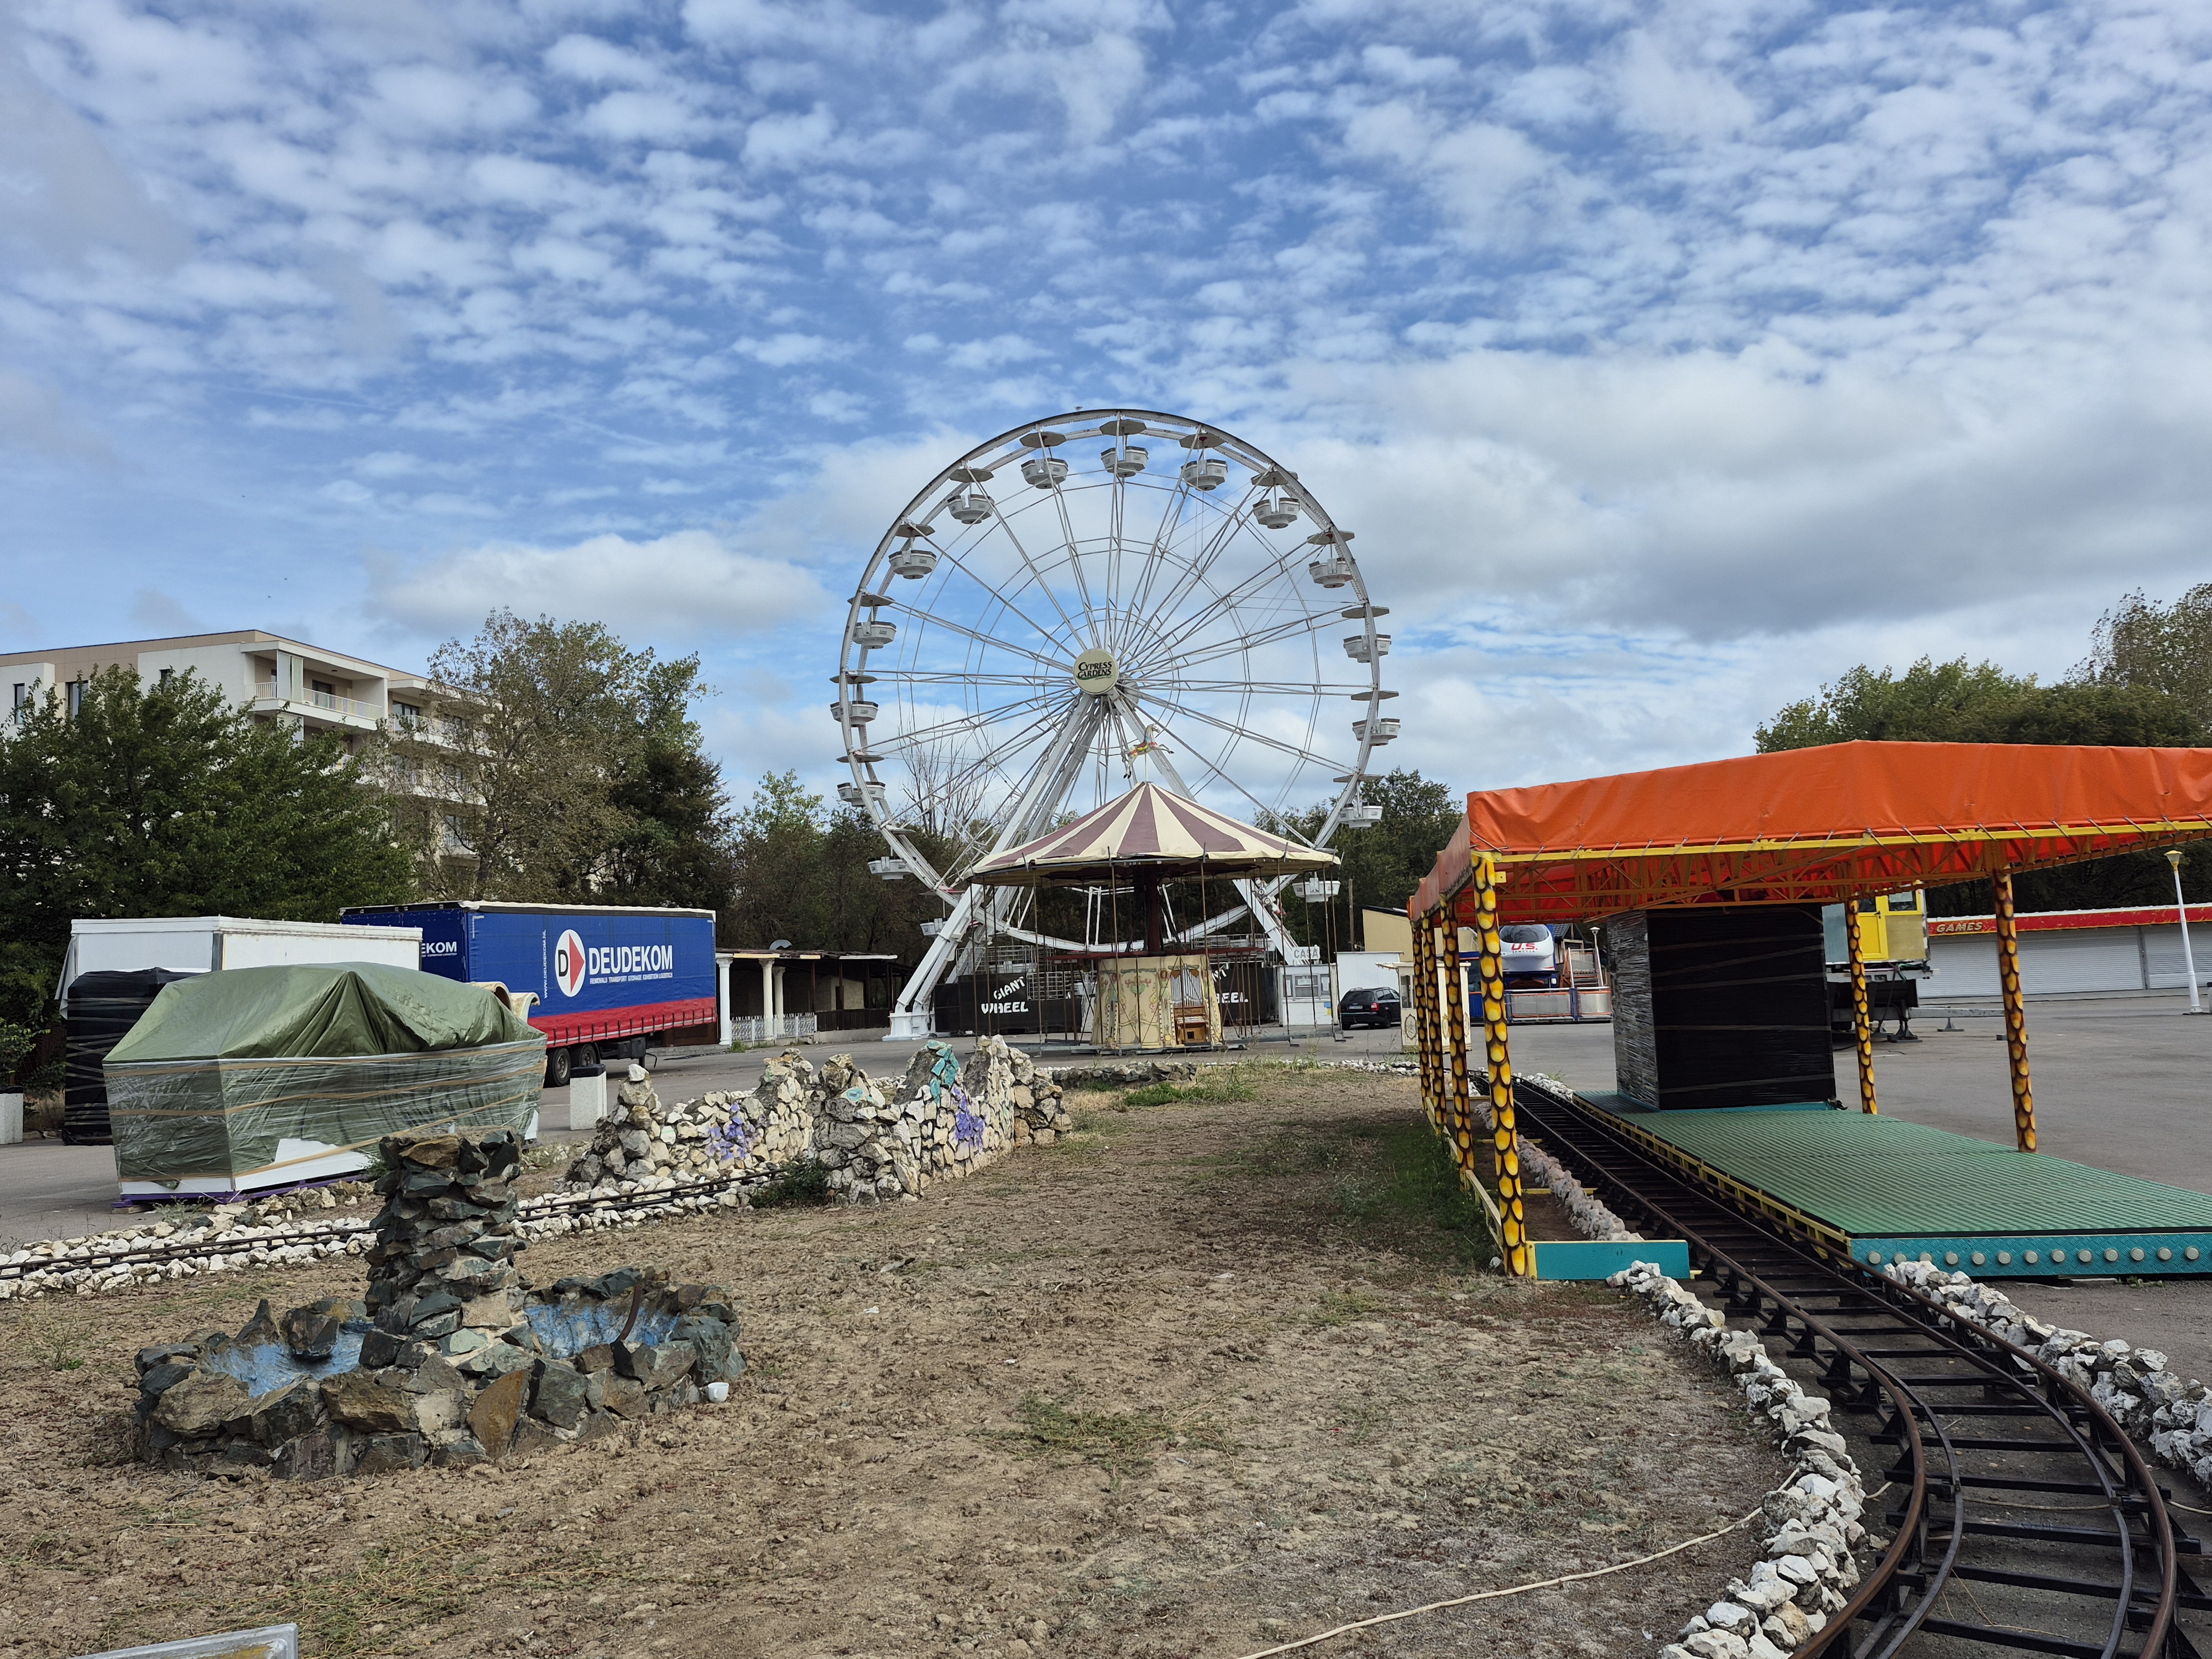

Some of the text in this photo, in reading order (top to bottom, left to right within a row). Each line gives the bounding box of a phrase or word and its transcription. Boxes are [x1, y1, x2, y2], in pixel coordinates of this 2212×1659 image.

[1078, 661, 1112, 671] CYPRESS
[1077, 669, 1112, 678] GARDENS
[1937, 922, 1983, 932] GAMES
[1294, 948, 1319, 958] CASA
[558, 950, 568, 977] D
[588, 945, 673, 975] DEUDEKOM
[993, 976, 1025, 1000] GIANT
[981, 1001, 1029, 1014] WHEEL
